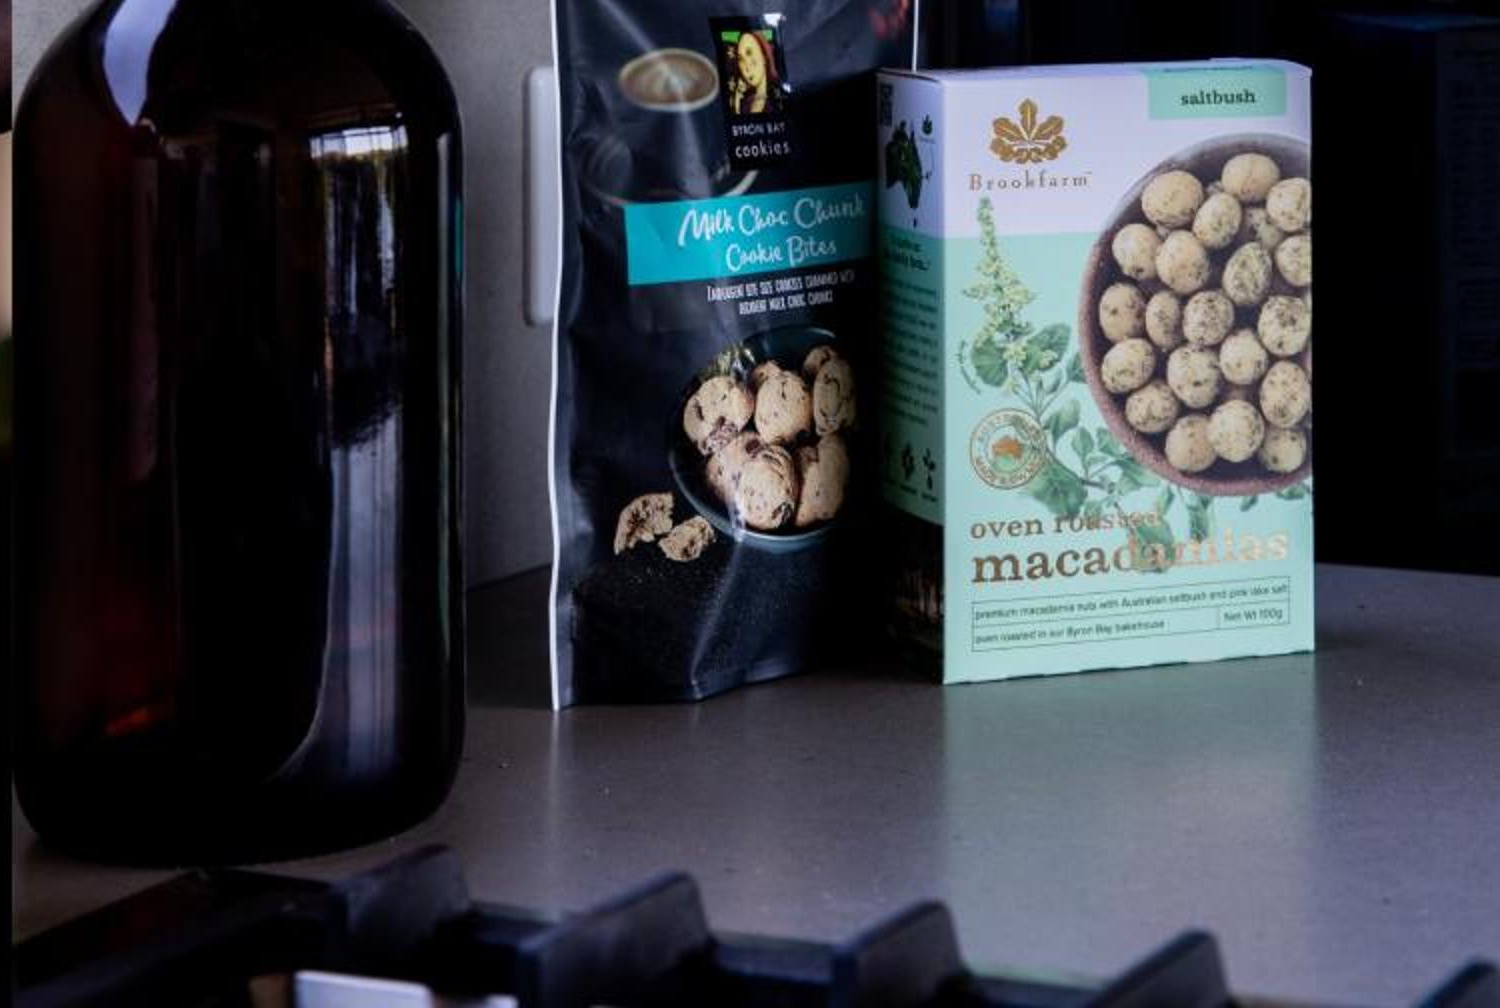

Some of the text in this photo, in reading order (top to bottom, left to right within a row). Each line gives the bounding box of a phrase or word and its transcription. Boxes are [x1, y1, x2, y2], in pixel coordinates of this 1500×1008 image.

[1180, 89, 1256, 107] saltbush
[735, 139, 789, 159] cookies
[968, 169, 1088, 192] Brookfarm
[677, 192, 865, 247] Milk Choc Chunk
[725, 235, 837, 272] Cookie Bites
[971, 506, 1159, 539] oven roasted
[971, 529, 1291, 583] macadamias
